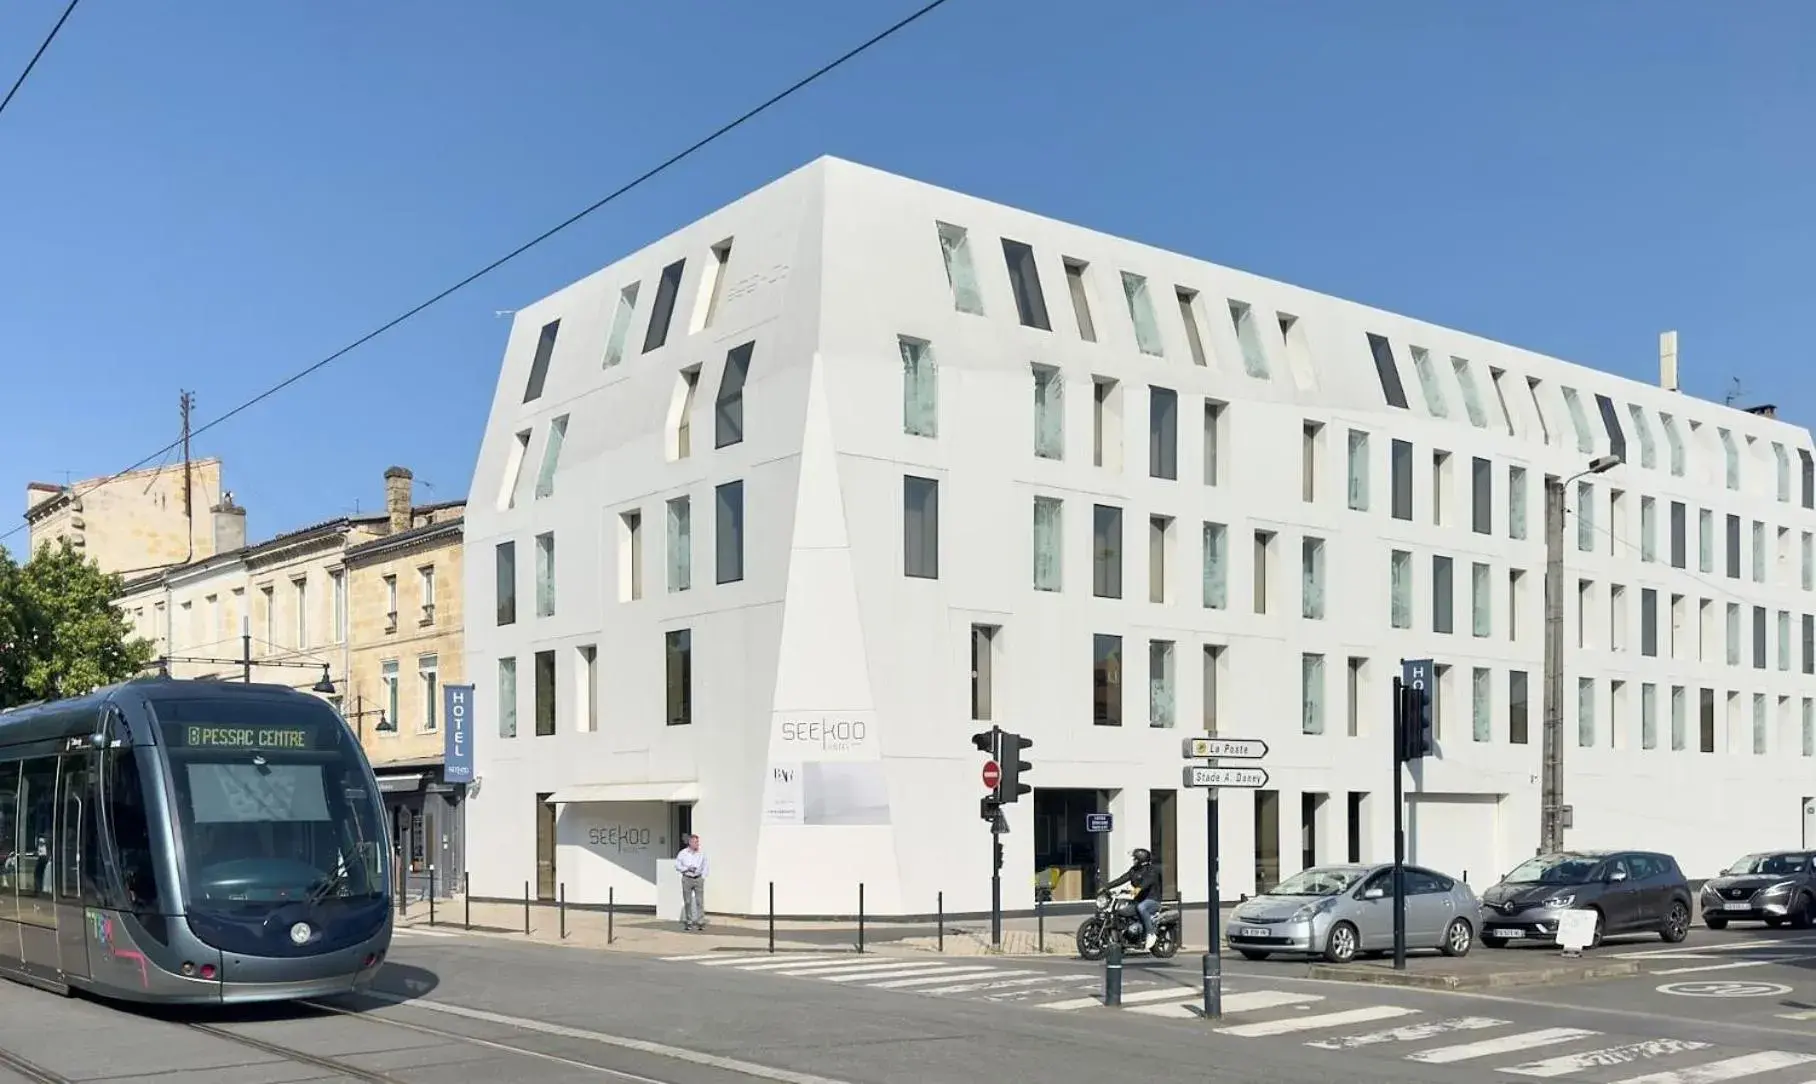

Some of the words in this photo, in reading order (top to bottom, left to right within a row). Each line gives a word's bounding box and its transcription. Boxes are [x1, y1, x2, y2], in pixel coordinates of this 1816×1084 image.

[453, 692, 465, 757] HOTEL
[203, 728, 253, 746] PESSAC
[258, 730, 306, 748] CENTRE
[1210, 743, 1220, 753] La
[1224, 744, 1249, 754] Poste
[1196, 772, 1220, 782] Stade
